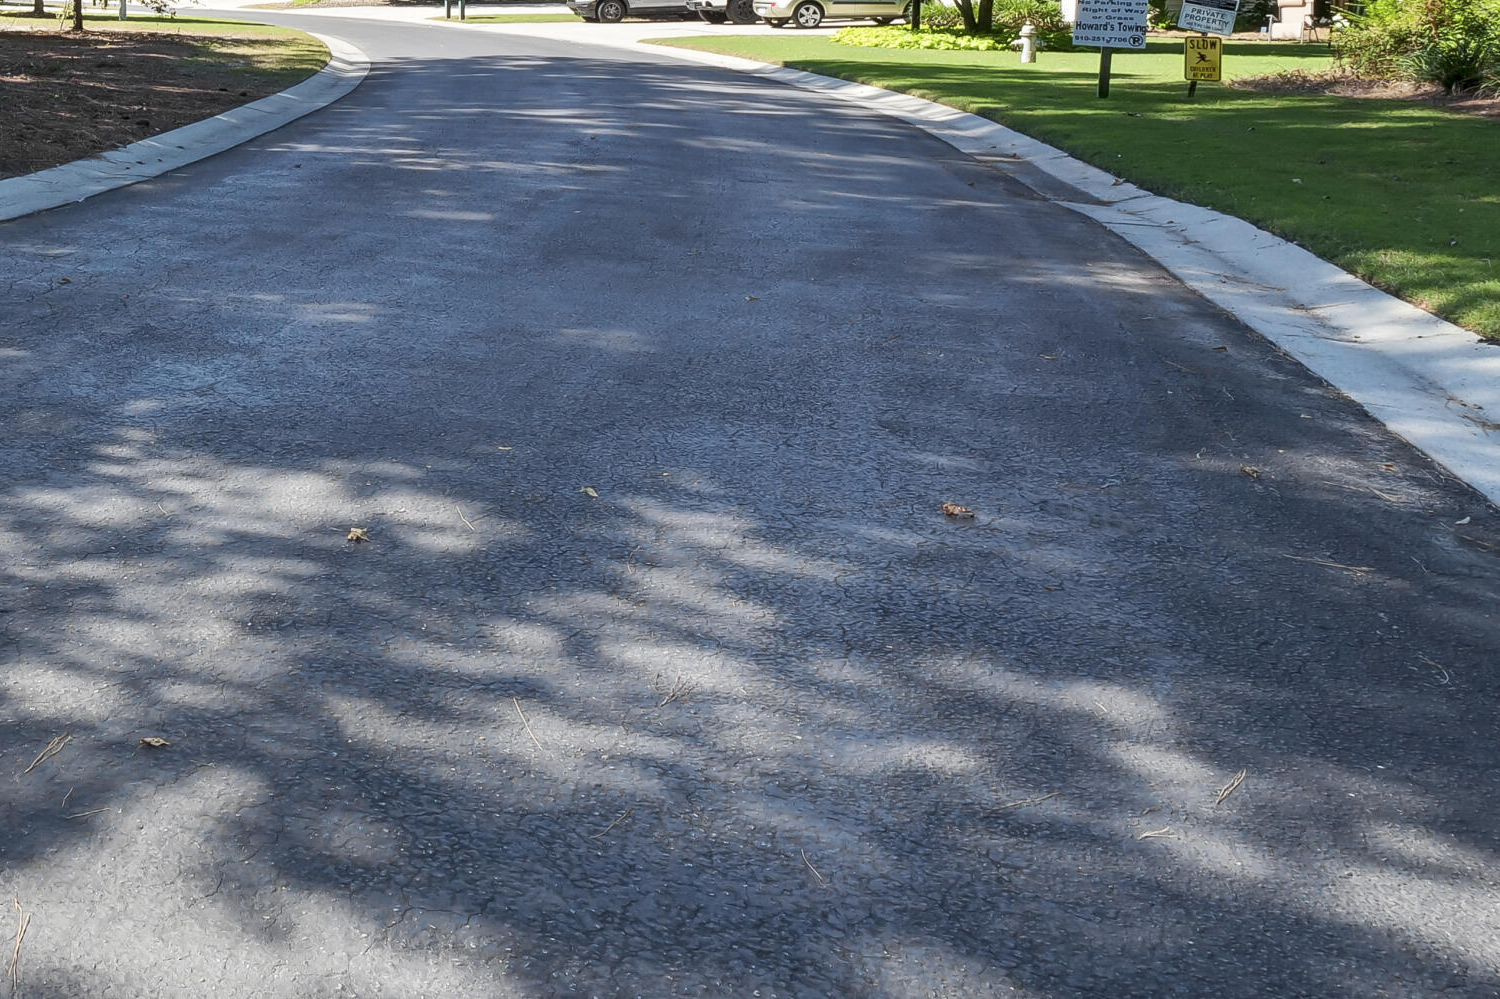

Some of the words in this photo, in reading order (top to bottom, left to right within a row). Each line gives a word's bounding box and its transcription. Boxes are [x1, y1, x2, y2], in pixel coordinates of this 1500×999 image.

[1191, 7, 1227, 19] PRIVATE
[1184, 13, 1229, 27] PROPERTY
[1076, 21, 1115, 31] Howard's
[1117, 22, 1147, 35] Towing
[1189, 39, 1217, 49] SLOW
